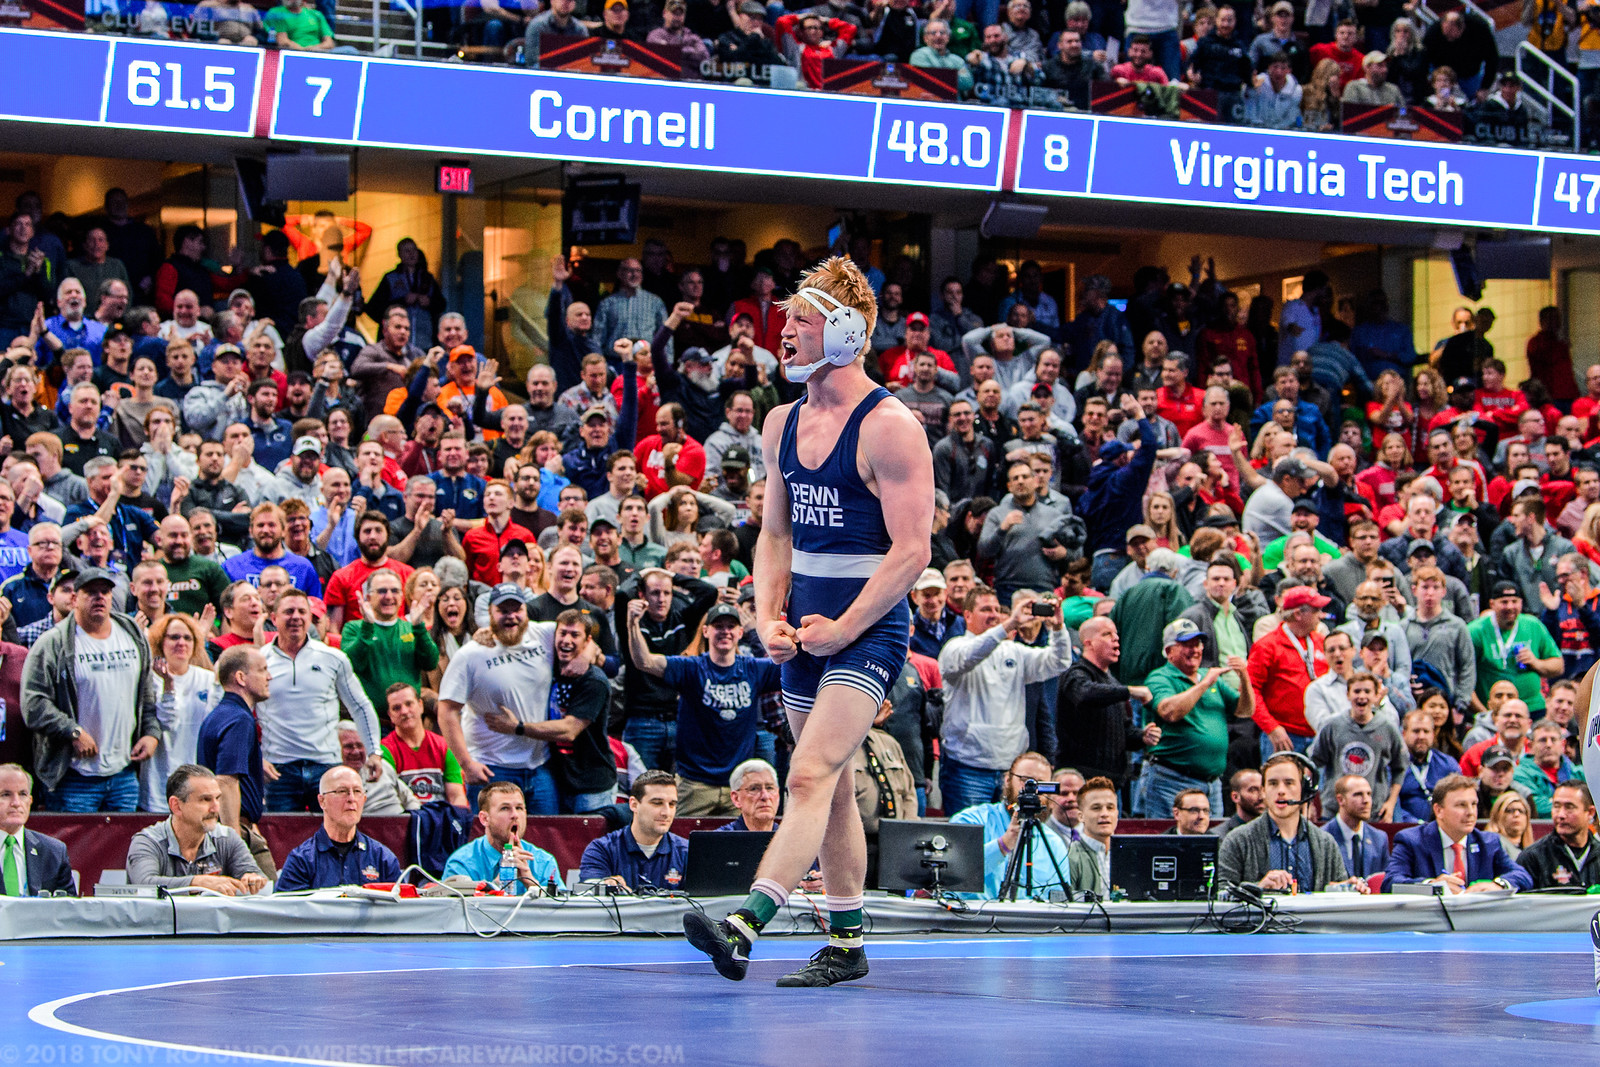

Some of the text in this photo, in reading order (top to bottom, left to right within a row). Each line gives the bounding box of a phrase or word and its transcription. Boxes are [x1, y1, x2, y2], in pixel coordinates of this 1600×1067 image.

[102, 10, 220, 36] CLU EVEL
[701, 60, 747, 77] CLUB
[128, 60, 235, 112] 61.5
[306, 76, 333, 117] 7
[530, 89, 715, 150] Cornell
[887, 119, 991, 168] 48.0
[1044, 134, 1069, 172] 8
[441, 166, 471, 192] EXIT
[1170, 139, 1463, 206] Virginia Tech
[790, 482, 839, 506] PENN
[792, 502, 844, 527] STATE
[486, 653, 513, 669] PENN
